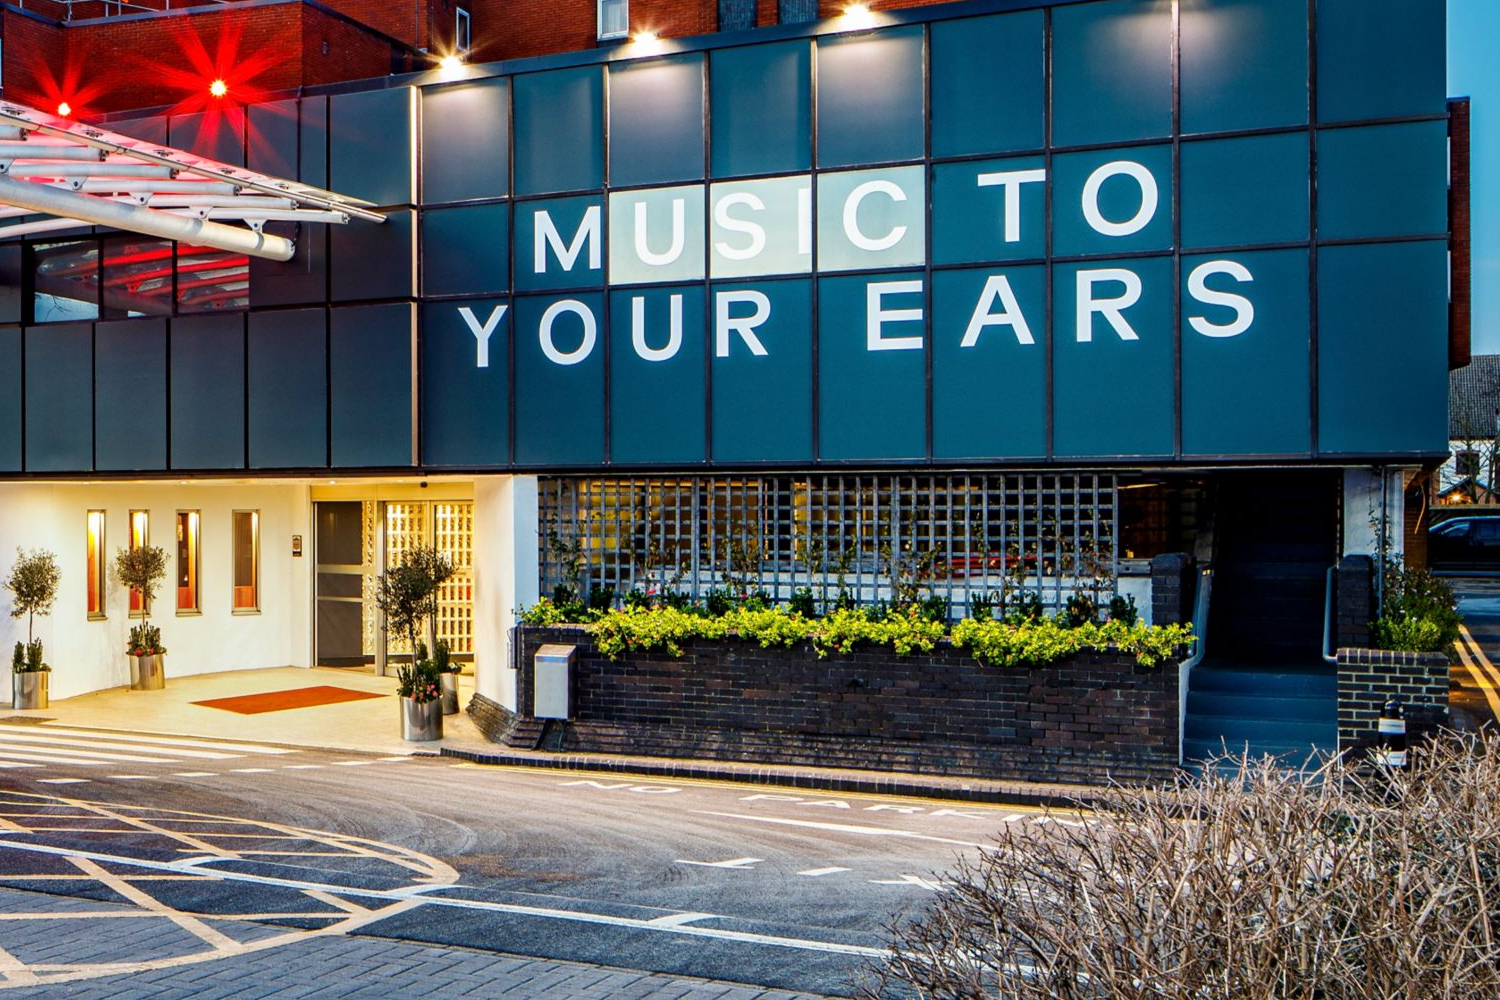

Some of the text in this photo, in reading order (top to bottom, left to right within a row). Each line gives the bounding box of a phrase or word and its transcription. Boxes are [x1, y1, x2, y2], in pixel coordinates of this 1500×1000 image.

[533, 159, 1159, 273] MUSIC TO
[456, 259, 1255, 368] YOUR EARS
[558, 780, 683, 794] NO
